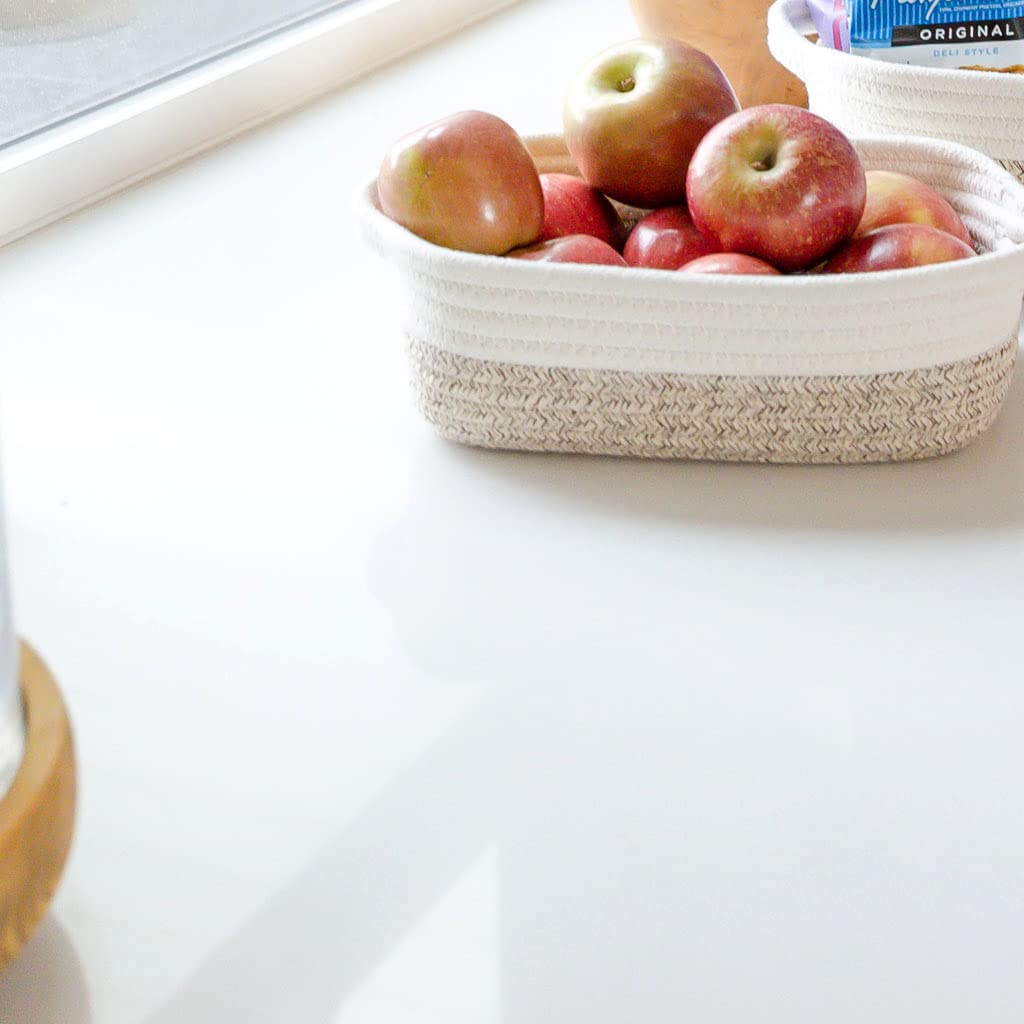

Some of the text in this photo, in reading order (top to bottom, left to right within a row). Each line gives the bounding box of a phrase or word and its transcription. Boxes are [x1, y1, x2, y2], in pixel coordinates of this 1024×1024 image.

[919, 23, 1015, 40] ORIGINAL
[933, 47, 999, 57] DELI STYLE
